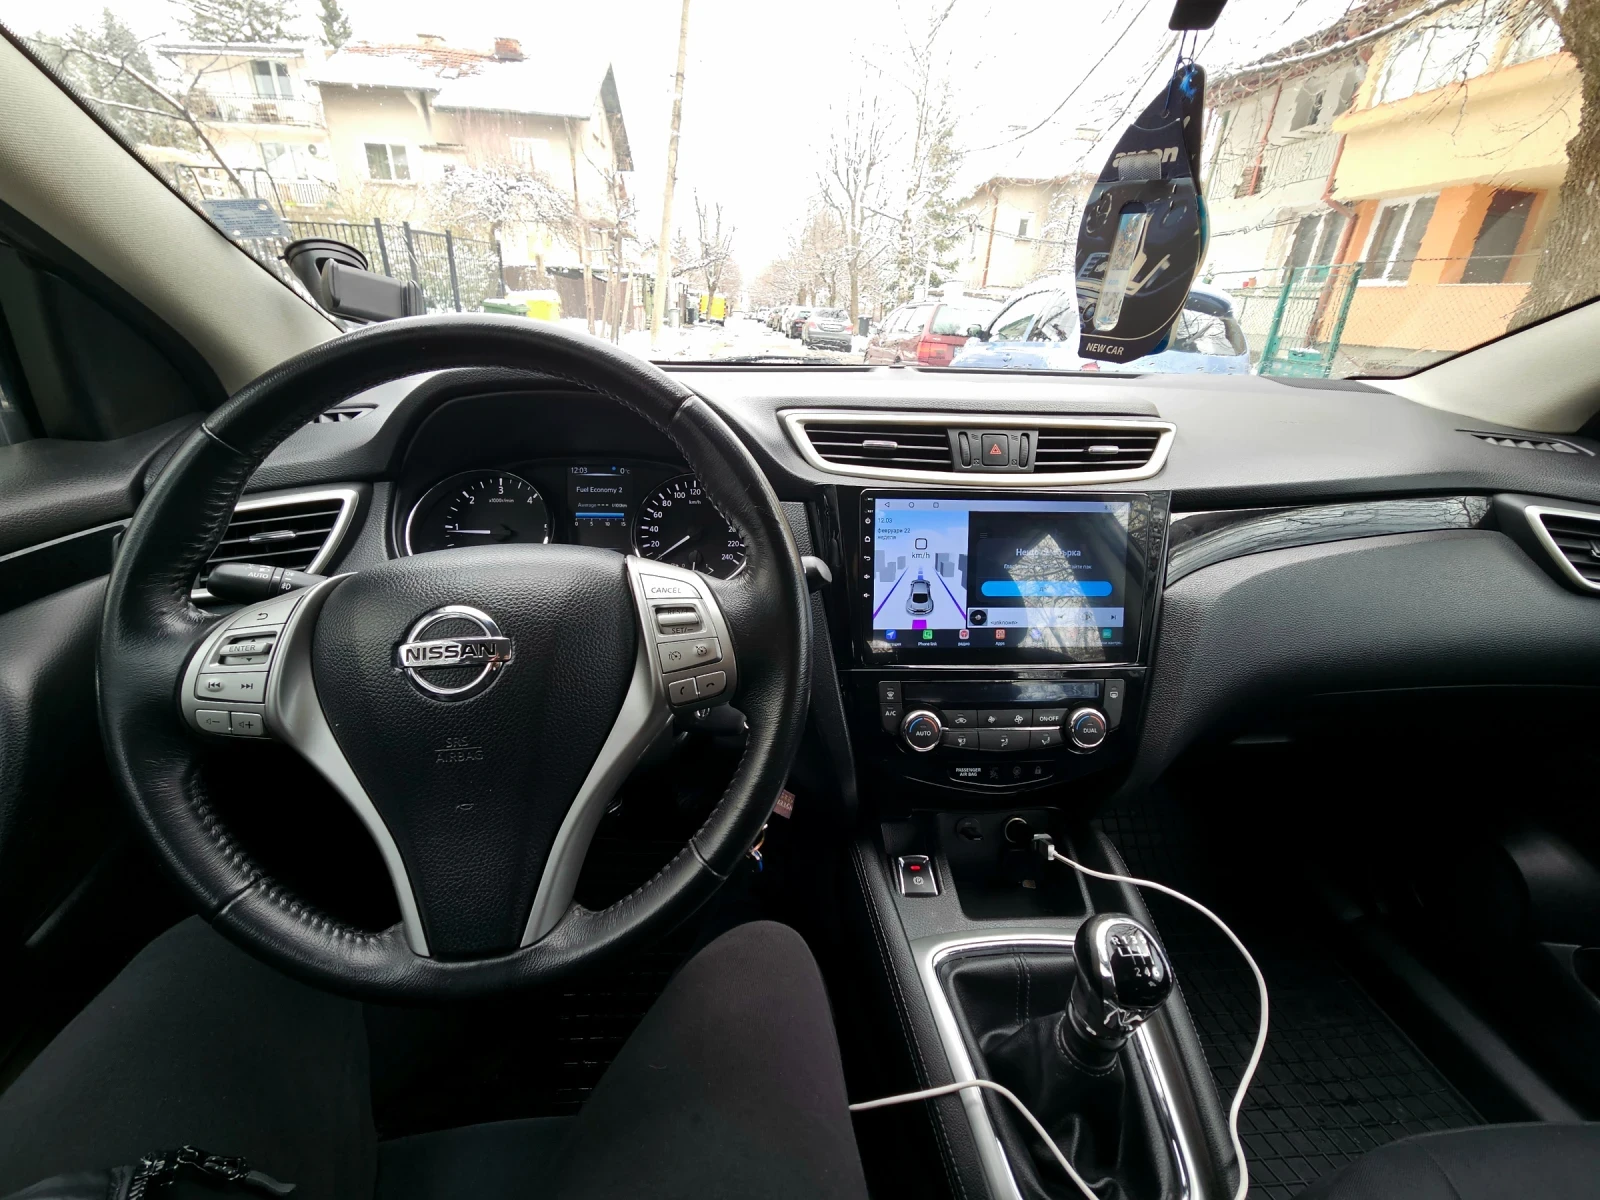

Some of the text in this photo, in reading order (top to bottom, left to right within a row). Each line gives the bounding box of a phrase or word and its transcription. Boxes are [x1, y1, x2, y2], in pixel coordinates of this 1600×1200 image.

[1085, 342, 1125, 355] NEW CAR
[498, 486, 504, 494] 3
[590, 486, 617, 494] Economy
[674, 491, 686, 499] 100
[469, 496, 475, 504] 2
[526, 496, 533, 504] 4
[454, 523, 459, 531] 1
[248, 571, 269, 579] AUTO
[651, 586, 681, 594] CANCEL
[228, 644, 256, 653] ENTER
[405, 643, 497, 663] NISSAN
[446, 736, 470, 748] SRS
[435, 750, 484, 763] AIRBAG
[1111, 935, 1121, 945] R
[1121, 936, 1129, 945] 1
[1130, 935, 1138, 945] 3
[1134, 966, 1160, 978] 2 4 6
